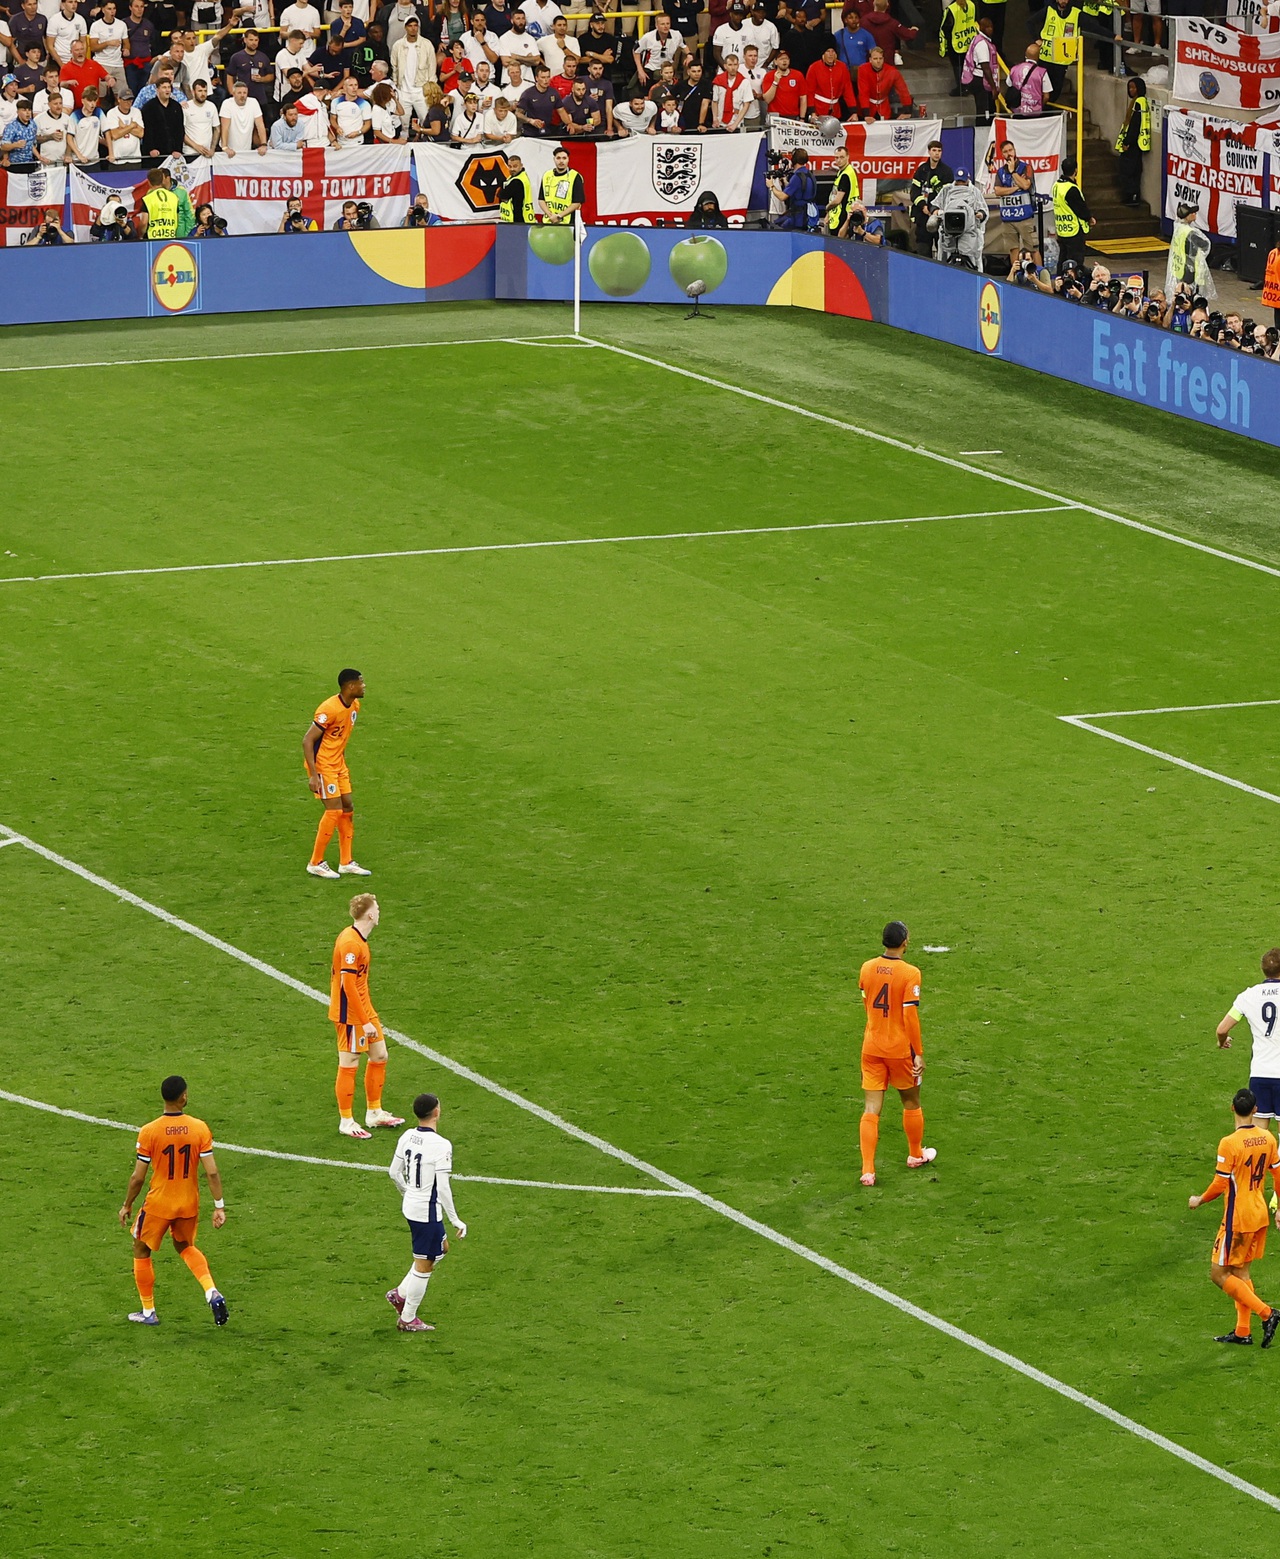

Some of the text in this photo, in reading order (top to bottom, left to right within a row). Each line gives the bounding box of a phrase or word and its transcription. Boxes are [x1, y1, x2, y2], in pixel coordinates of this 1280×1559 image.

[364, 47, 374, 61] D
[1185, 47, 1276, 74] SHREWSBURY
[777, 128, 792, 136] THE
[794, 128, 818, 137] BORO
[783, 138, 835, 147] ARE IN TOWN
[234, 176, 392, 198] WORKSOP TOWN FC
[1169, 157, 1261, 196] THE ARSENAL
[1093, 319, 1250, 428] Eat fresh
[873, 983, 889, 1017] 4
[1261, 988, 1279, 997] KANE
[1261, 1001, 1277, 1037] 9
[166, 1125, 188, 1136] GAKPO
[162, 1144, 191, 1180] 11
[405, 1149, 422, 1188] 11
[1244, 1153, 1266, 1191] 14
